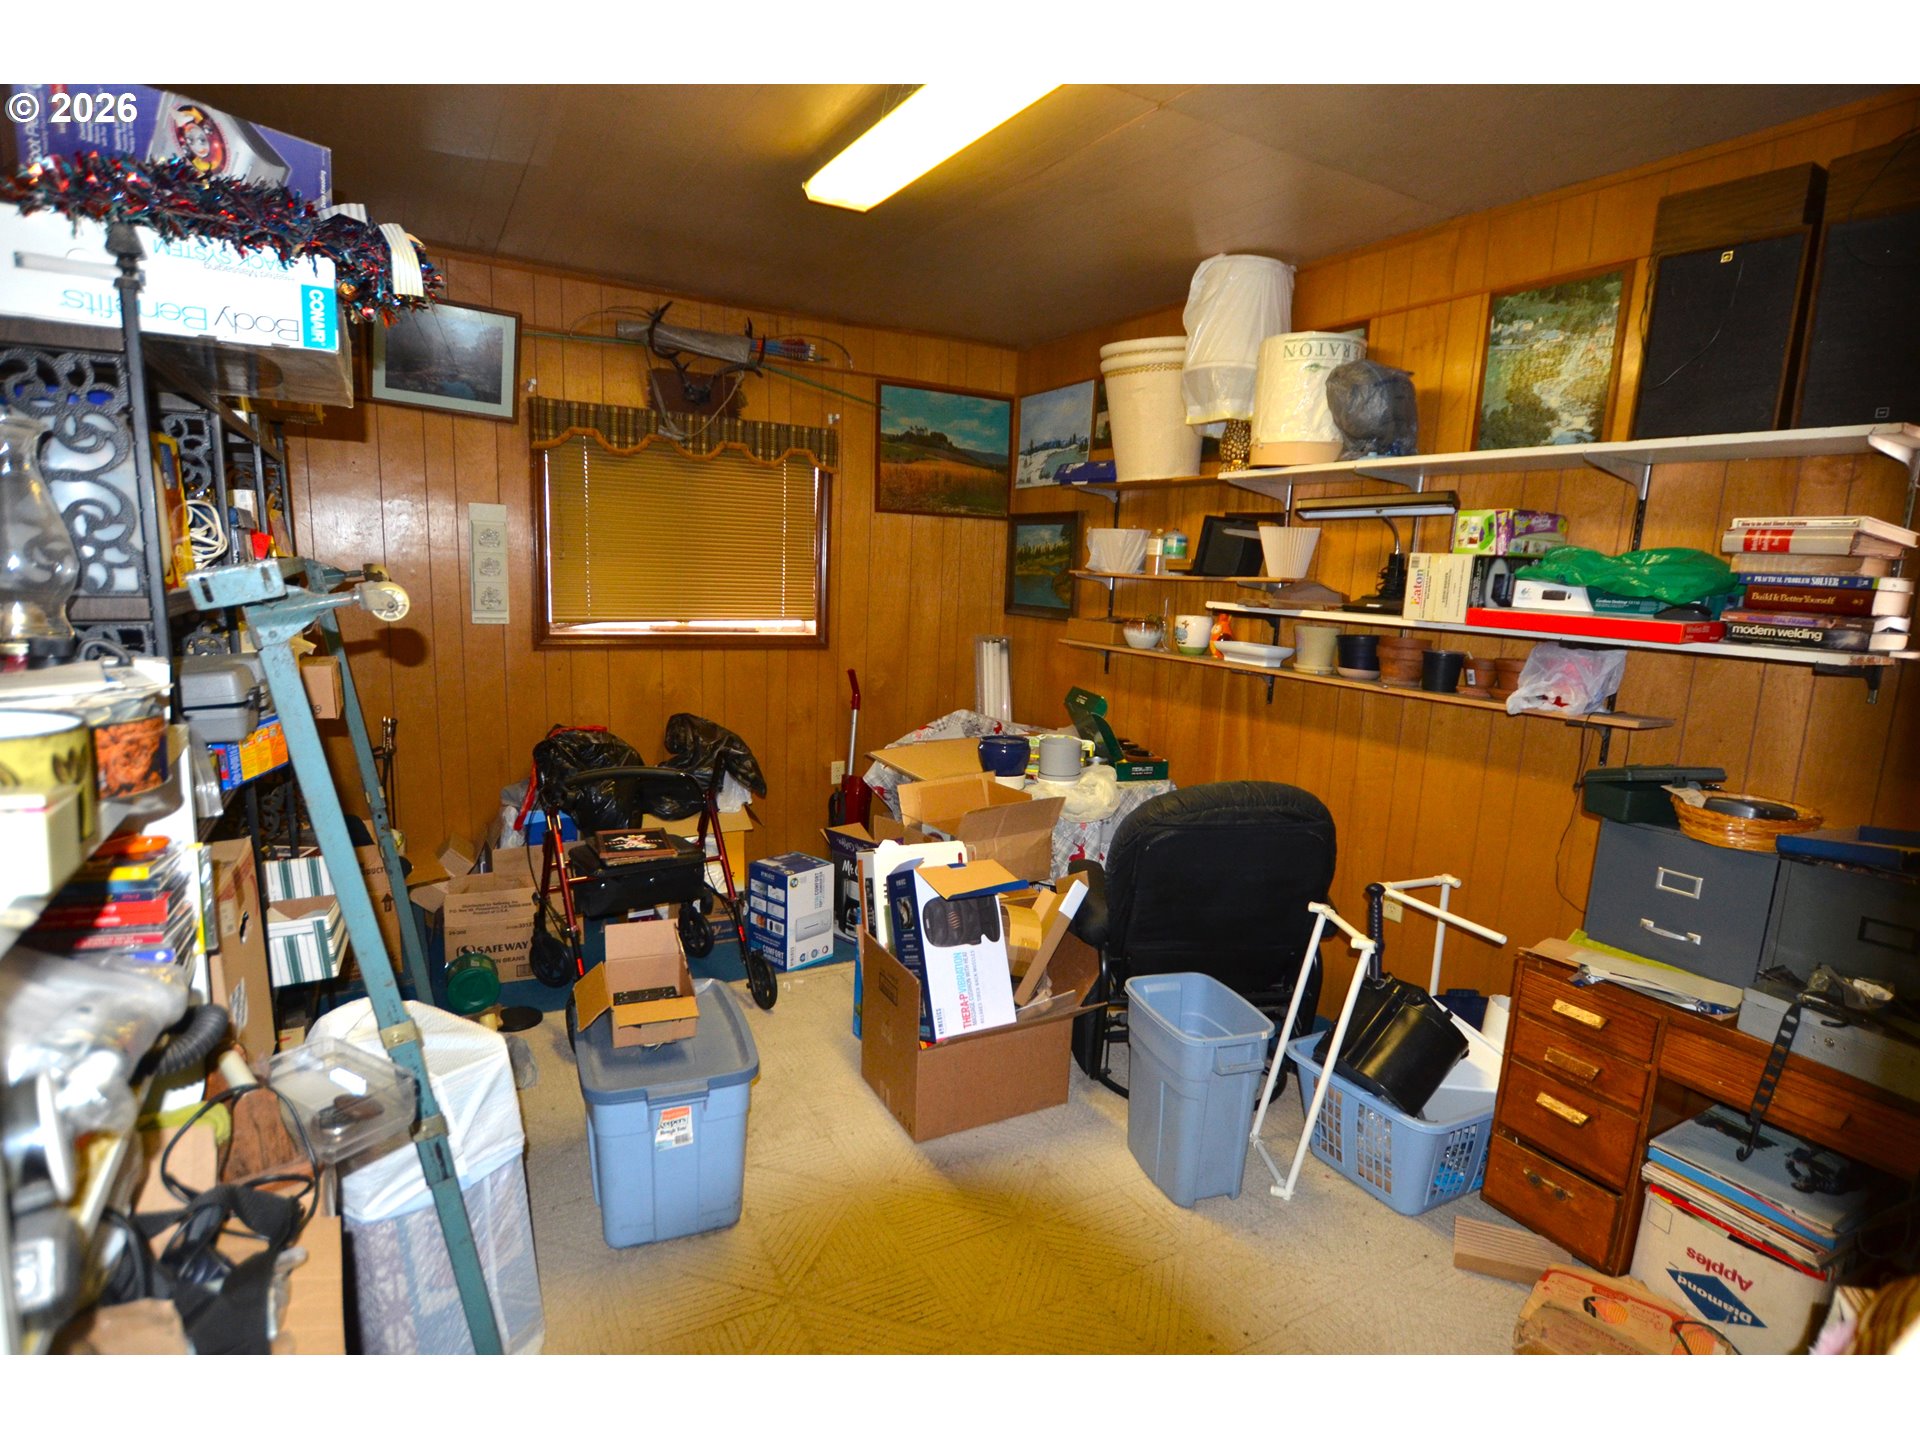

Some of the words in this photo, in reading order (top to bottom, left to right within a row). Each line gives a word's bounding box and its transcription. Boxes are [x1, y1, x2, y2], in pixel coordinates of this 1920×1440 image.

[153, 238, 231, 267] SYSTEM
[214, 305, 300, 343] Body
[308, 288, 326, 344] CONAIR
[1410, 569, 1424, 605] Eaton
[1754, 575, 1782, 583] PRACTICAL
[1784, 576, 1810, 585] PROBLEM
[1810, 576, 1840, 587] SOLVER
[1751, 591, 1773, 602] Build
[1780, 593, 1803, 604] Better
[1803, 594, 1836, 605] Yourself
[1731, 624, 1776, 637] modern
[1777, 627, 1824, 642] welding
[842, 859, 855, 876] Mr.
[477, 941, 529, 954] SAFEWAY
[970, 950, 978, 973] MUSCLES
[953, 952, 966, 994] VIBRATION
[1685, 1246, 1754, 1293] Apples
[1676, 1273, 1753, 1325] Diamond
